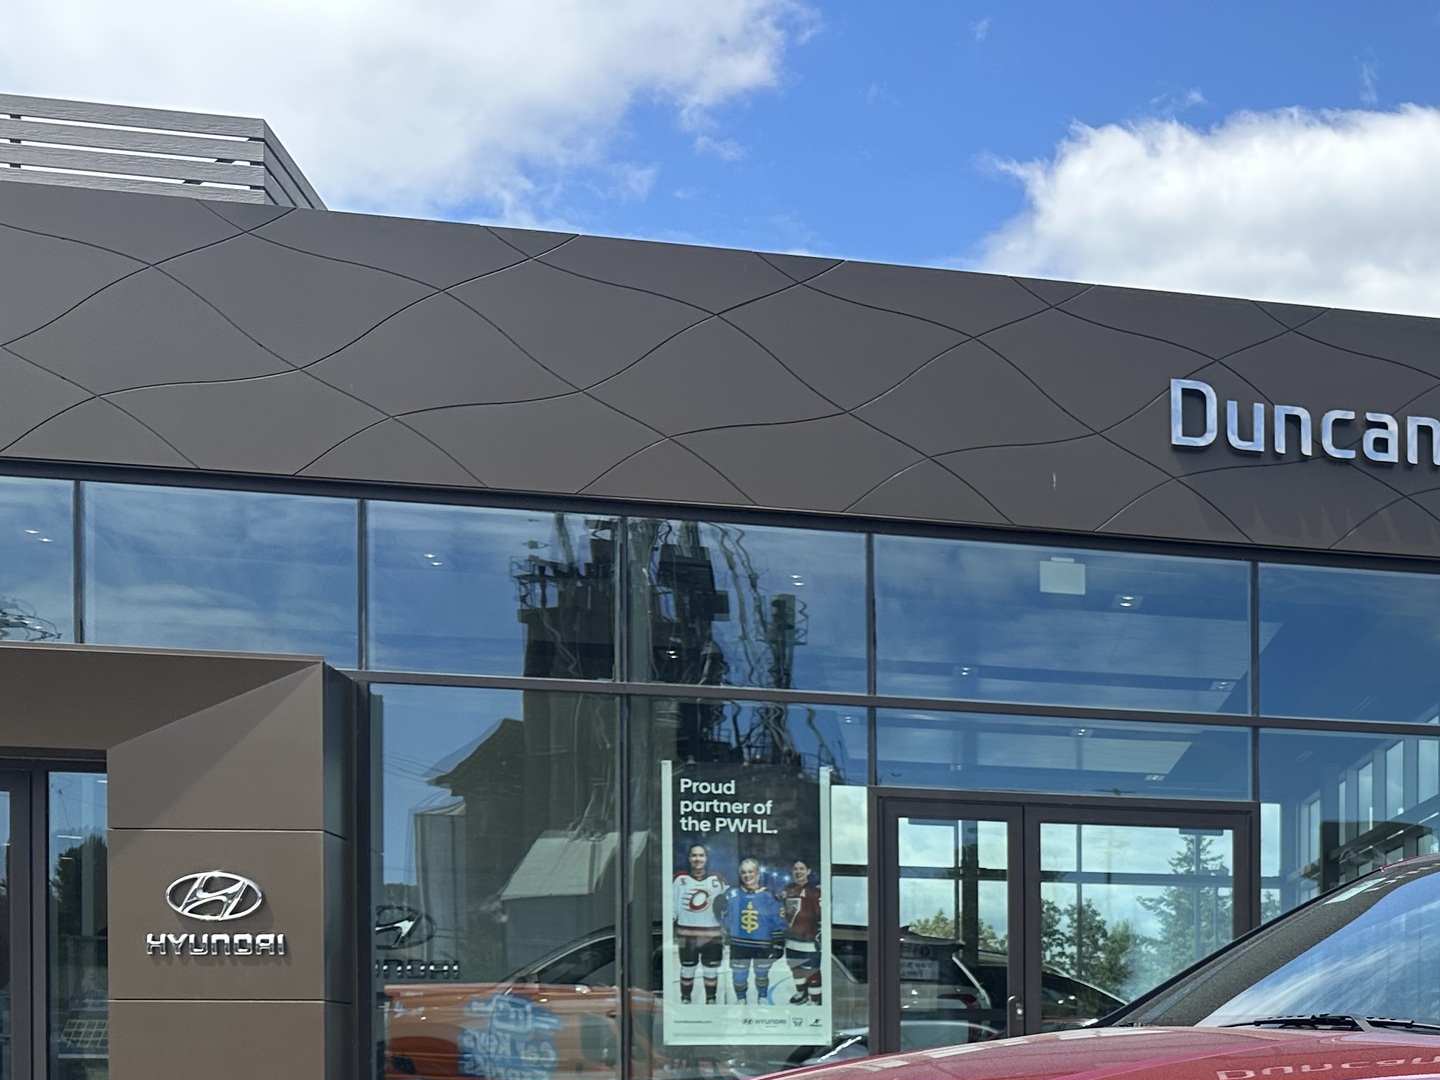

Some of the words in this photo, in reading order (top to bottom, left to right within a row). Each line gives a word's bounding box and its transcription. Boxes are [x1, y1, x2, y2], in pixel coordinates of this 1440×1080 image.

[680, 778, 736, 795] Proud
[680, 799, 751, 815] partner
[753, 800, 773, 815] of
[679, 816, 711, 832] the
[715, 817, 778, 834] PWHL.
[146, 933, 286, 956] HYUNDAI
